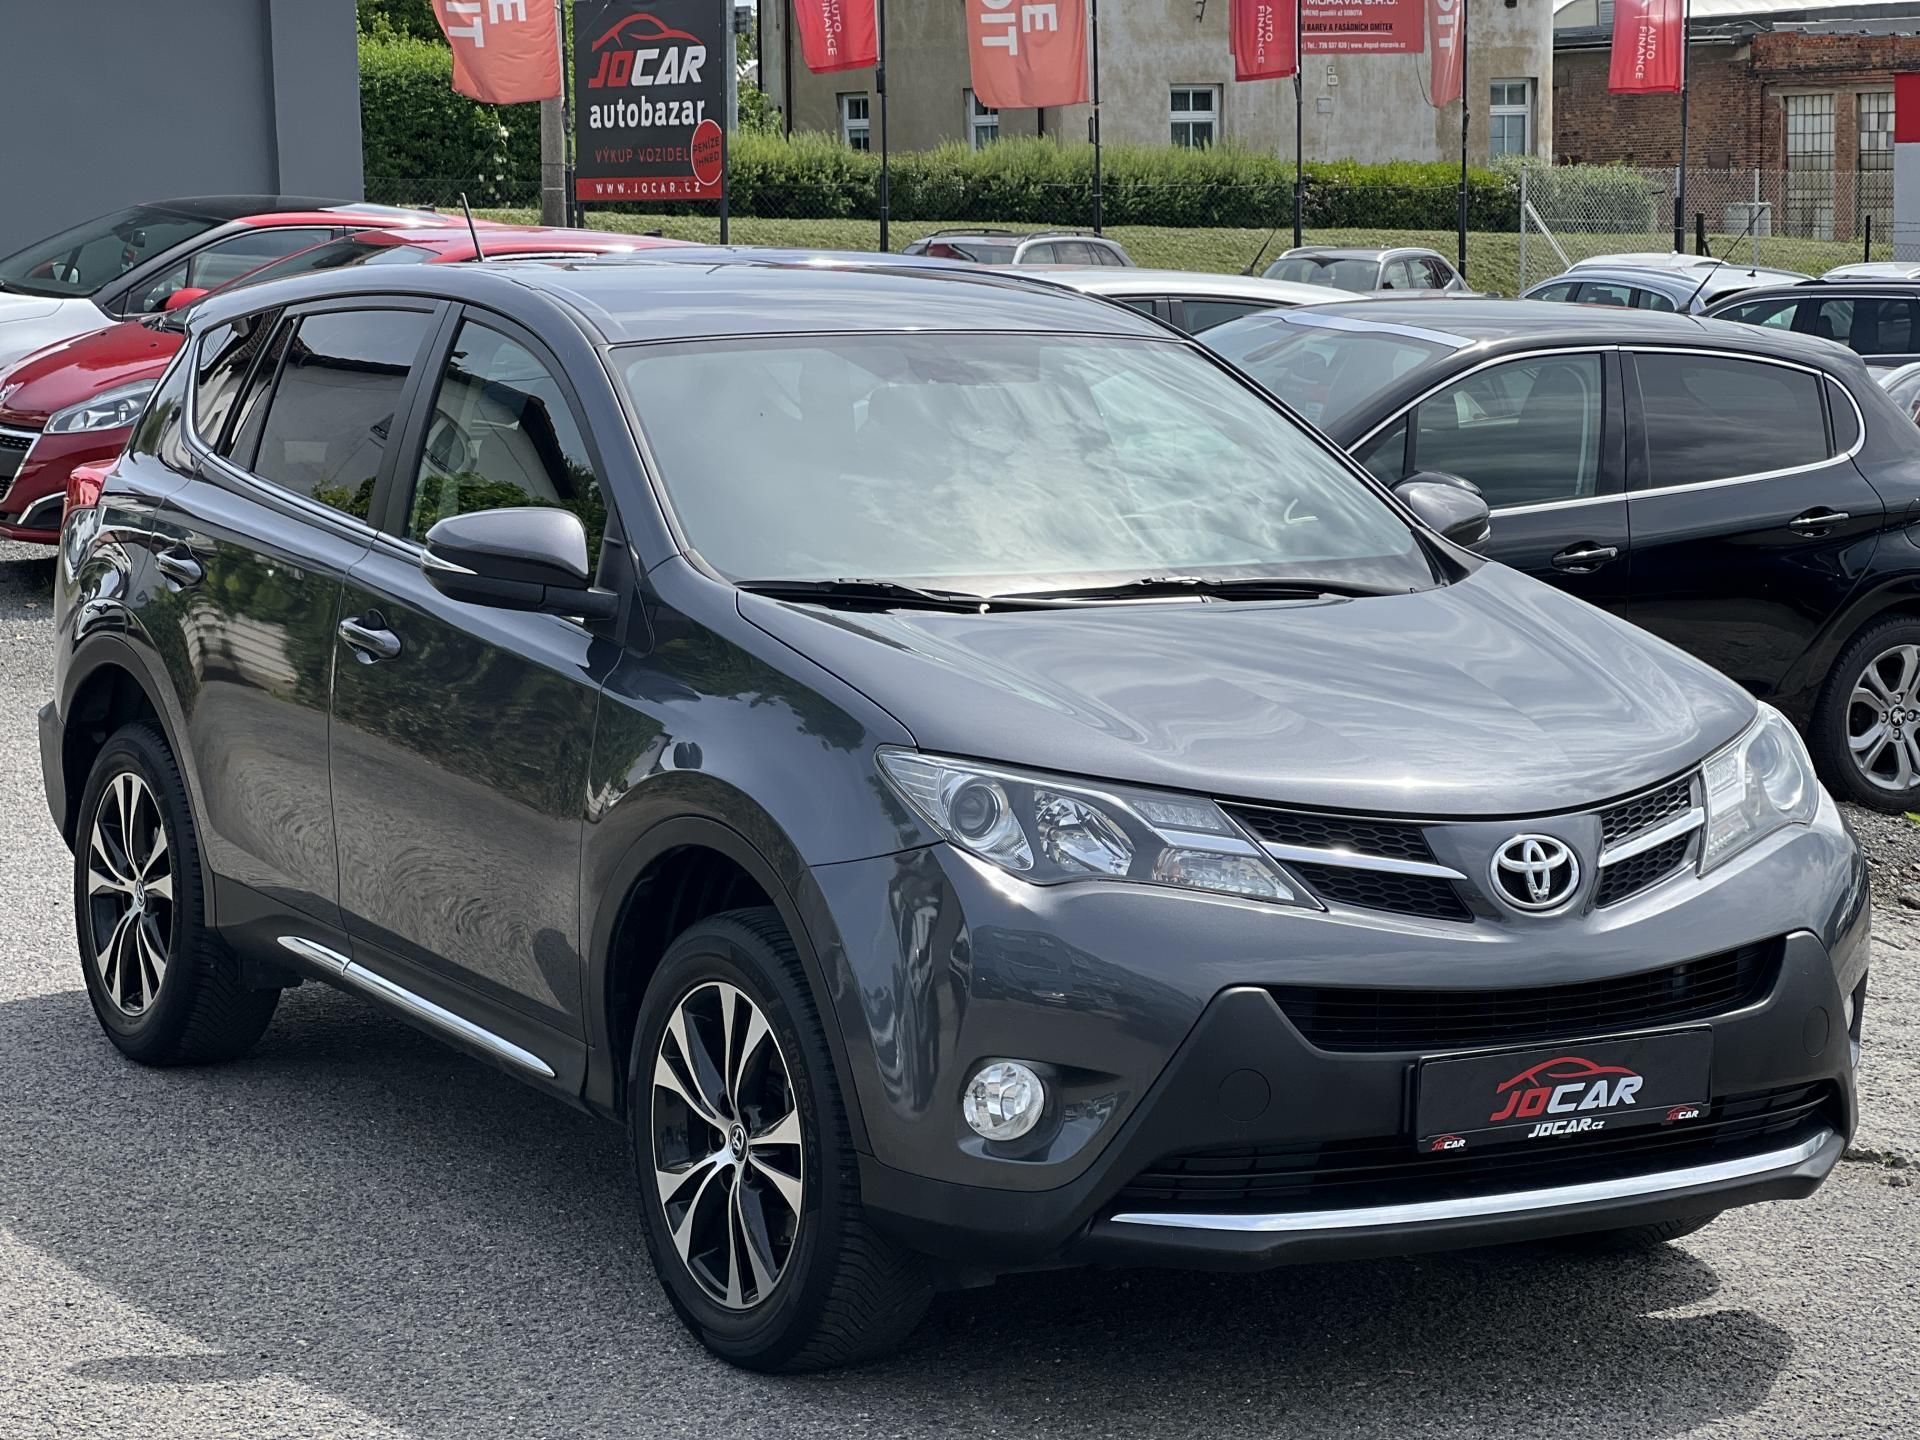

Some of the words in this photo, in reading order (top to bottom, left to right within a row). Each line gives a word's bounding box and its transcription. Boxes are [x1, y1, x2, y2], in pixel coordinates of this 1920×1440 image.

[1257, 5, 1265, 64] FINANCE
[1265, 5, 1273, 42] AUTO
[1635, 26, 1648, 79] FINANCE
[1646, 26, 1656, 60] AUTO
[588, 45, 707, 89] JOCAR
[589, 95, 705, 129] autobazar
[595, 146, 633, 163] VÝKUP
[639, 147, 690, 162] VOZIDEL
[595, 182, 701, 194] WWW.JOCAR.CZ
[1490, 1075, 1644, 1121] JOCAR
[1528, 1118, 1606, 1139] JOCAR.cz
